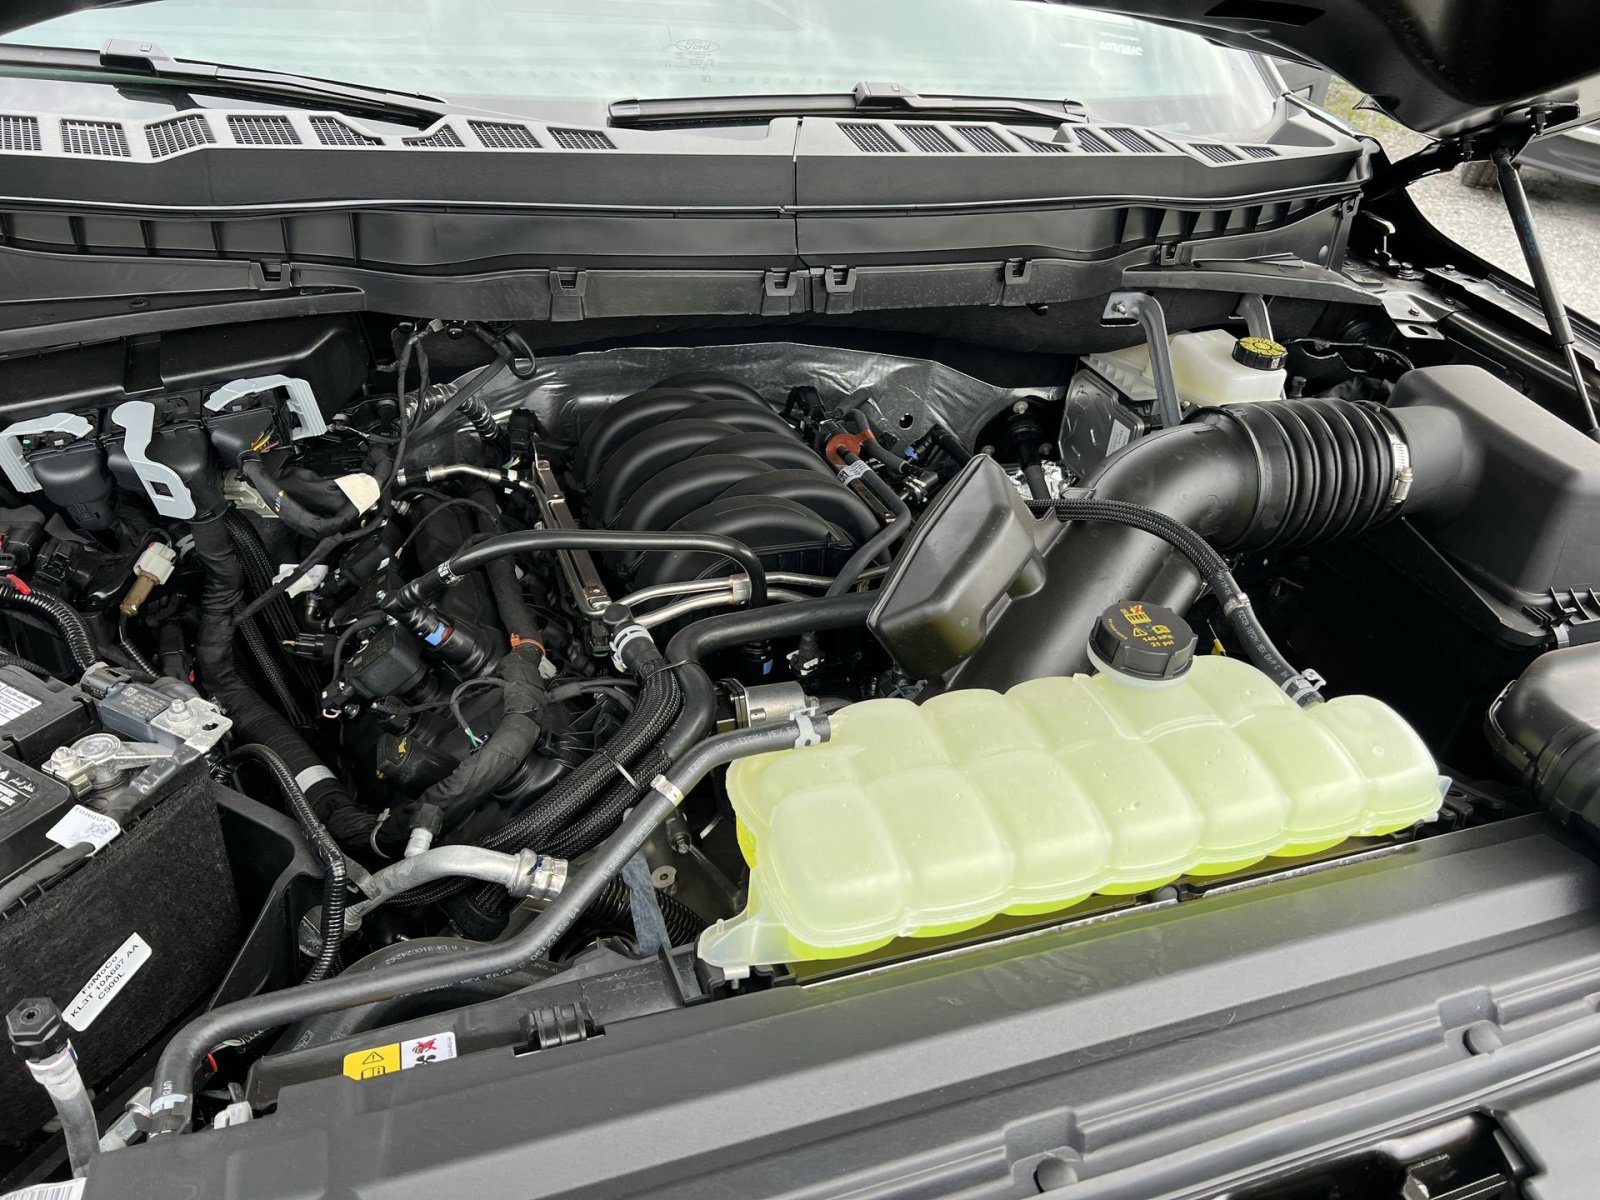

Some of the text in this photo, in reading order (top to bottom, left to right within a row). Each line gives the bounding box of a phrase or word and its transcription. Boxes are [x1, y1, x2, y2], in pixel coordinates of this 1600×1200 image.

[684, 41, 711, 51] Ford
[70, 992, 93, 1018] KL3T
[126, 944, 139, 958] AA
[81, 956, 118, 995] FoMoCo
[97, 971, 125, 1000] C500L
